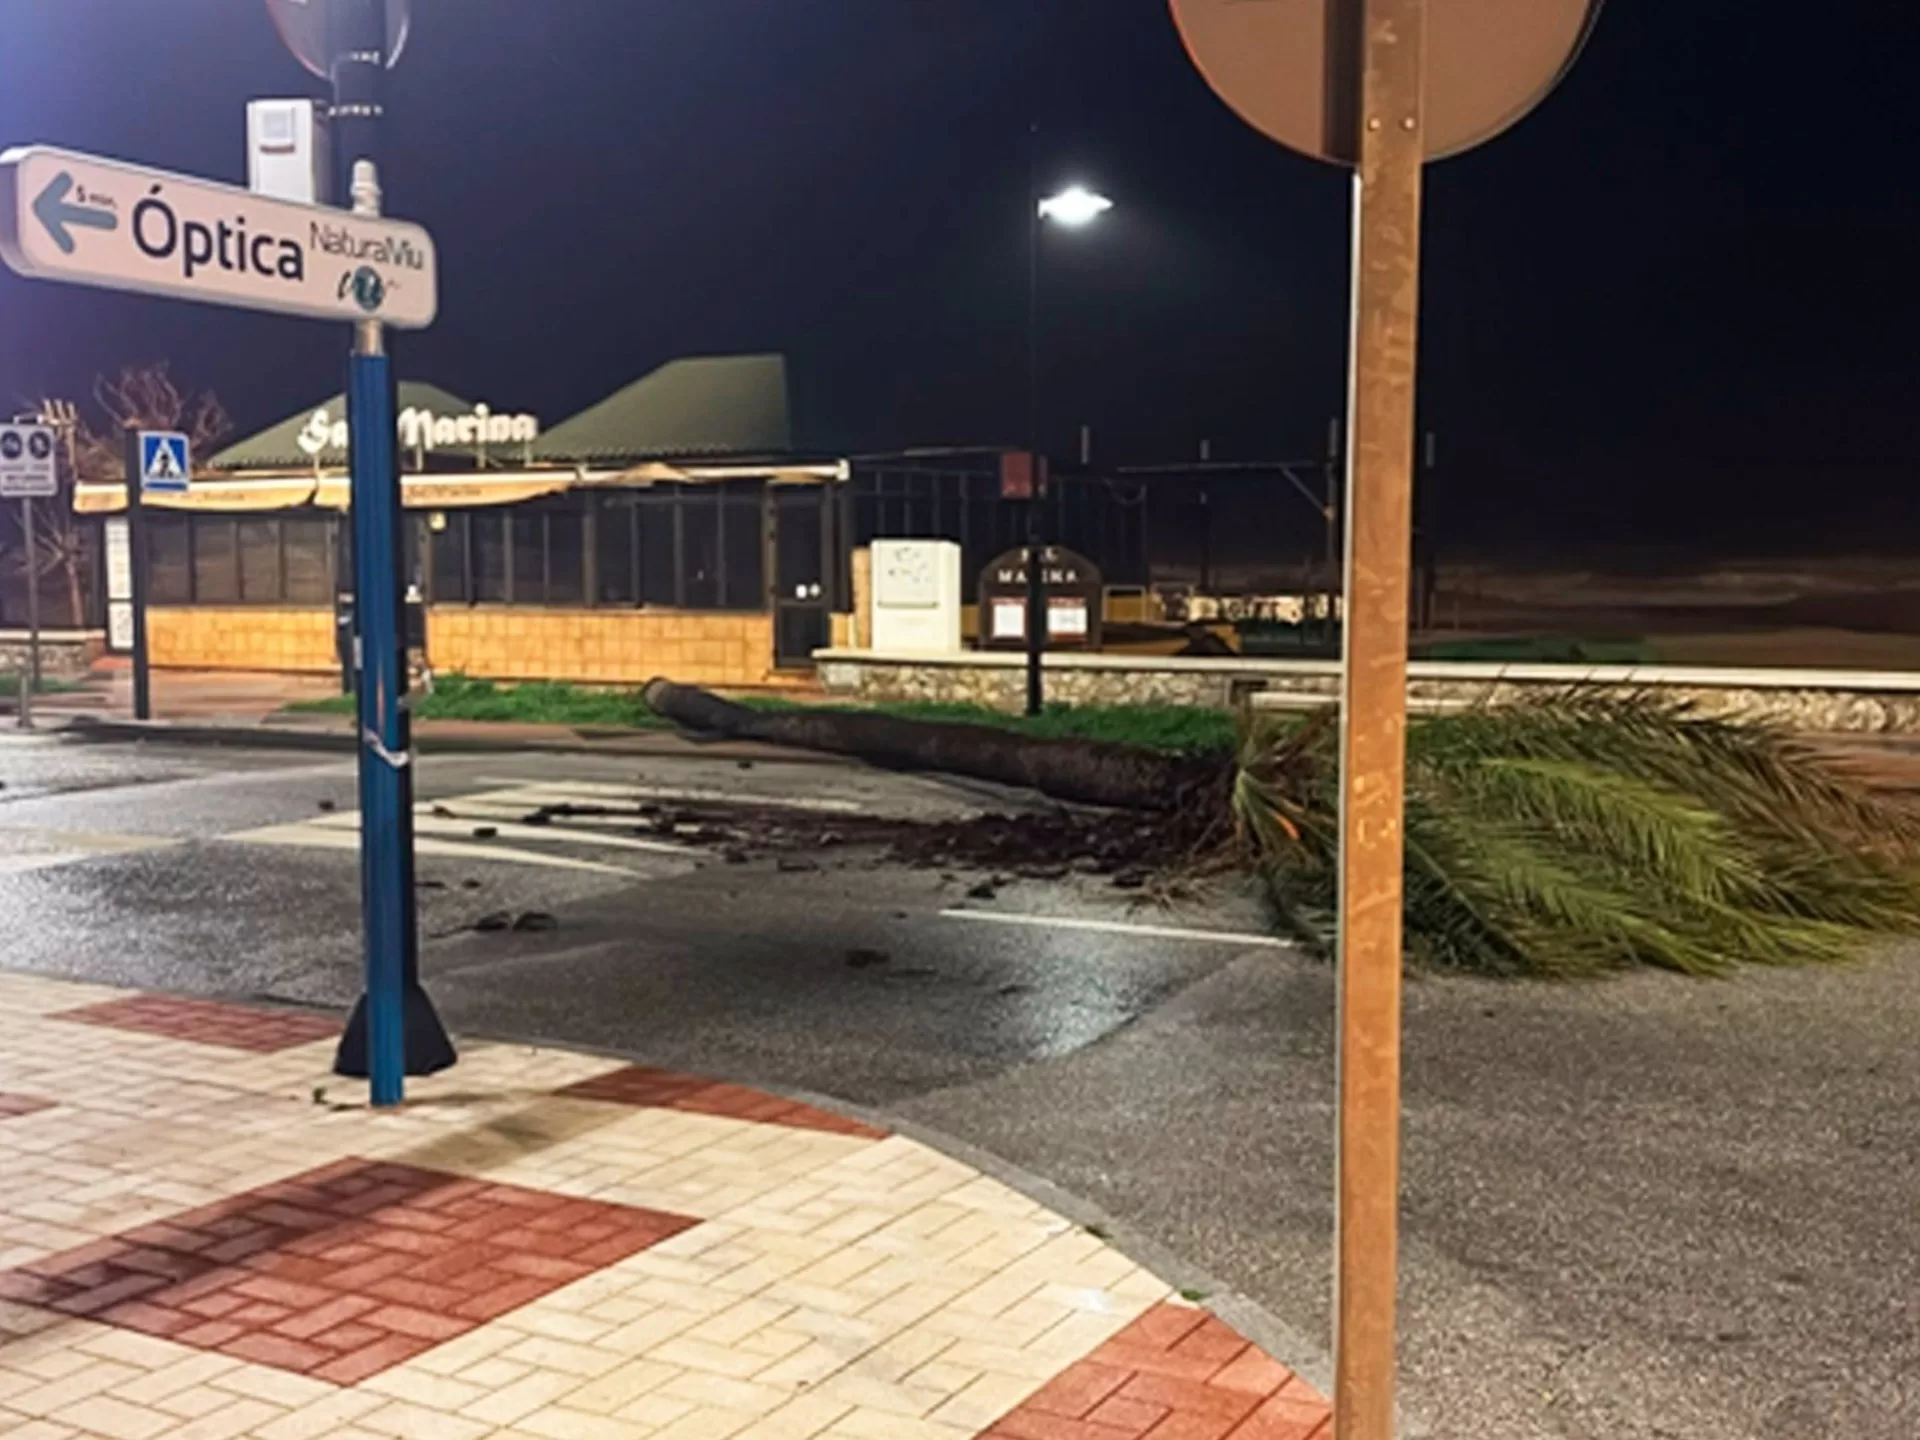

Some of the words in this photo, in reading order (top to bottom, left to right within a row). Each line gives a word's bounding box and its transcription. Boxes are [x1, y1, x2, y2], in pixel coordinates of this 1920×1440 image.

[132, 184, 304, 281] Óptica
[297, 408, 348, 454] Sa
[397, 402, 538, 450] Marina
[998, 569, 1078, 584] MAINA
